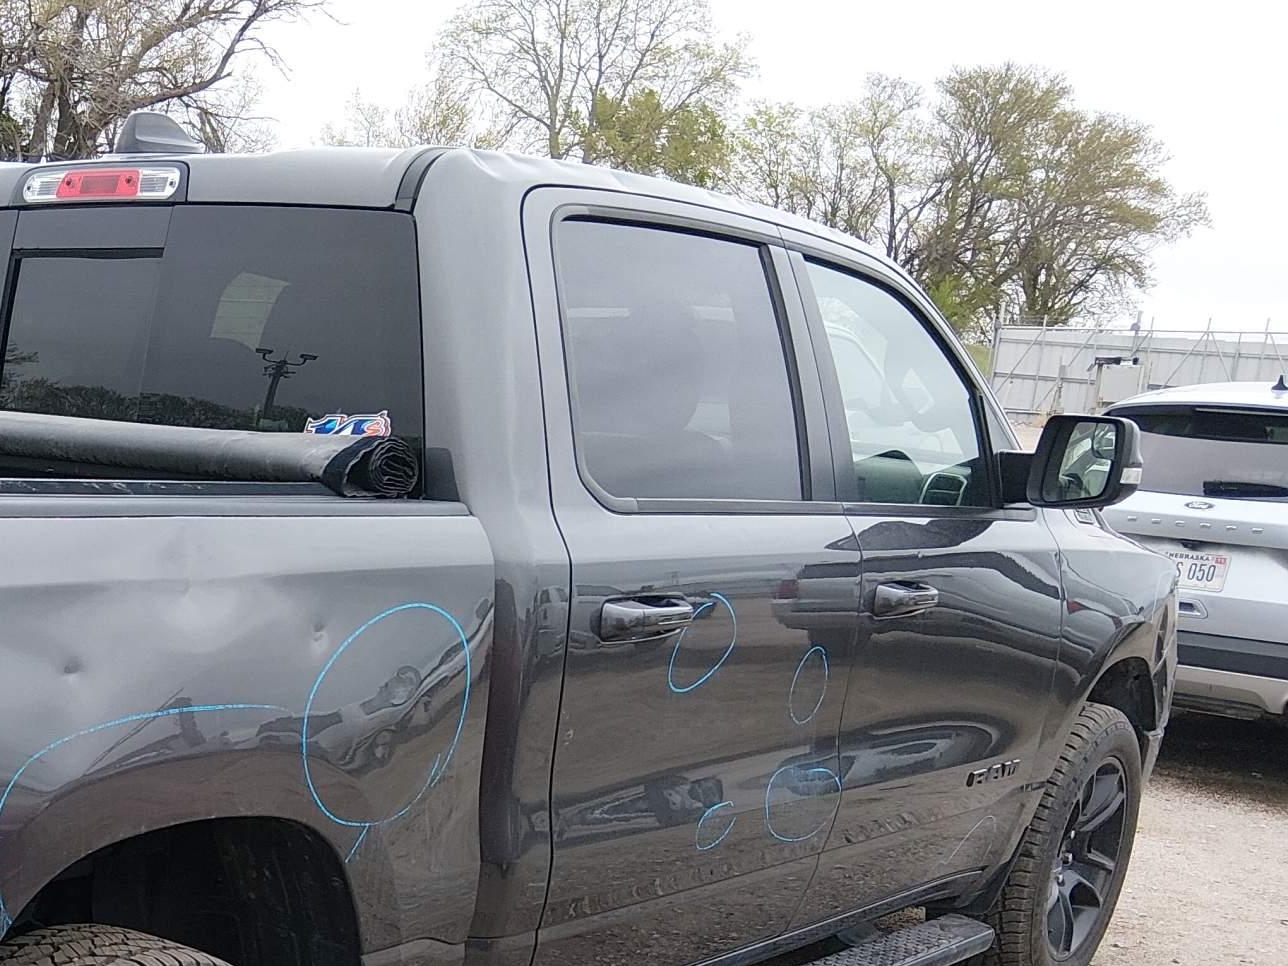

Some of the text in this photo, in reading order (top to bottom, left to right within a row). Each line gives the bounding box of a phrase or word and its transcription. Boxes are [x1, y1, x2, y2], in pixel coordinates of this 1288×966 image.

[1169, 551, 1210, 562] NEBRASKA
[1187, 562, 1217, 582] 050
[966, 758, 1021, 787] RAM
